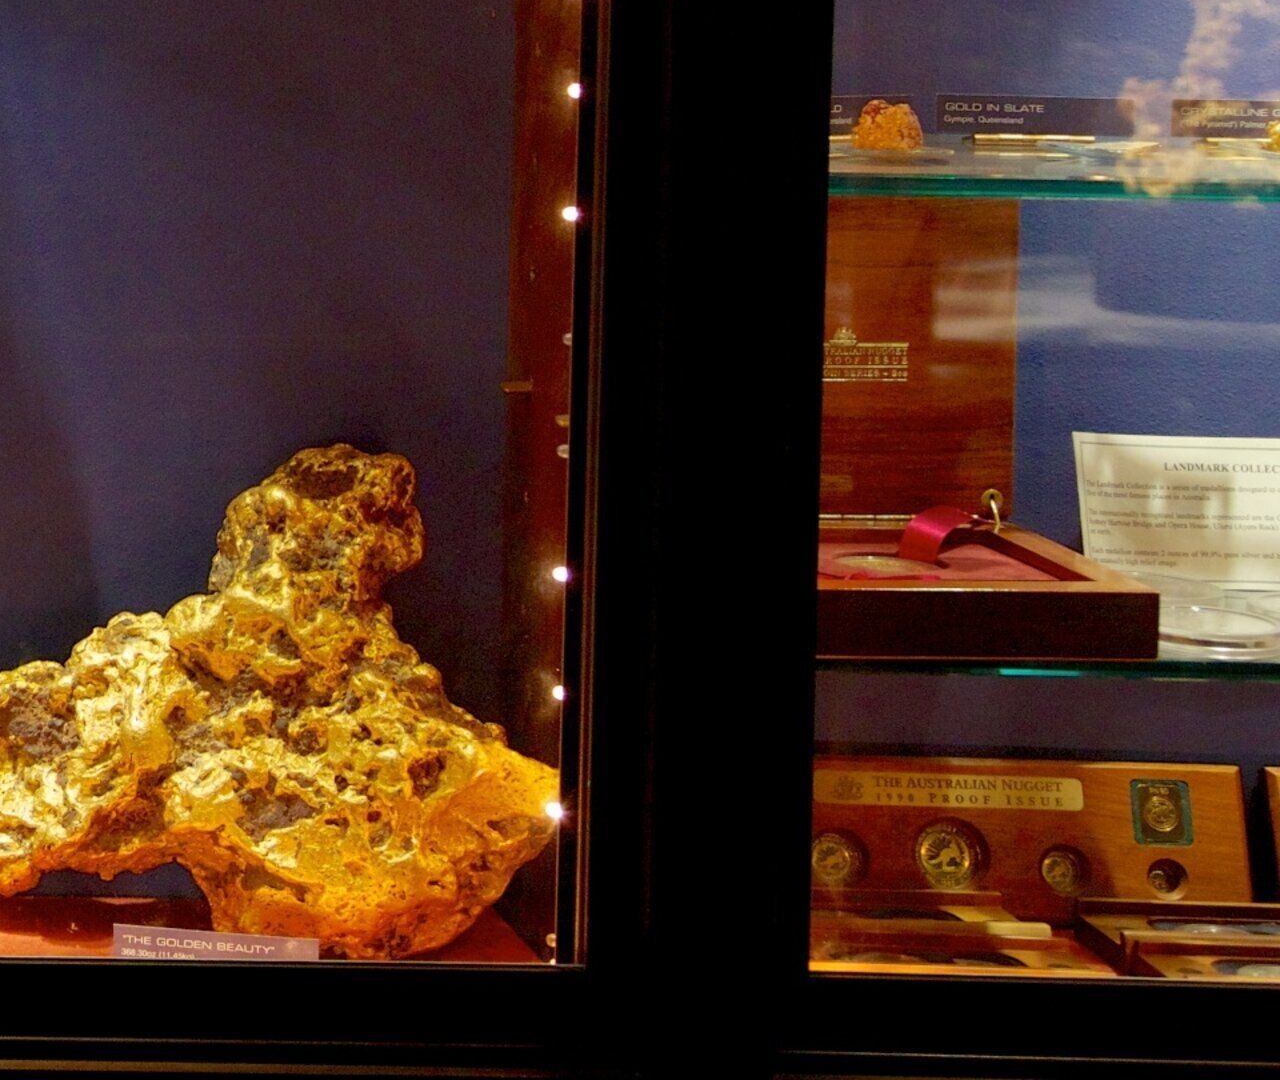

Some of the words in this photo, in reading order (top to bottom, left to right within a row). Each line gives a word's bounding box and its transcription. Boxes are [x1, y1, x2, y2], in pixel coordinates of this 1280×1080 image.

[944, 102, 983, 112] GOLD
[985, 103, 1000, 112] IN
[1003, 103, 1045, 113] SLATE
[1164, 462, 1229, 473] LANDMARK
[1232, 463, 1279, 474] COLLEC
[874, 775, 902, 788] THE
[906, 777, 997, 791] AUSTRALIAN
[1001, 779, 1062, 792] NUGGET
[929, 793, 991, 804] PROOF
[1007, 795, 1063, 806] ISSUE
[155, 936, 213, 950] GOLDEN
